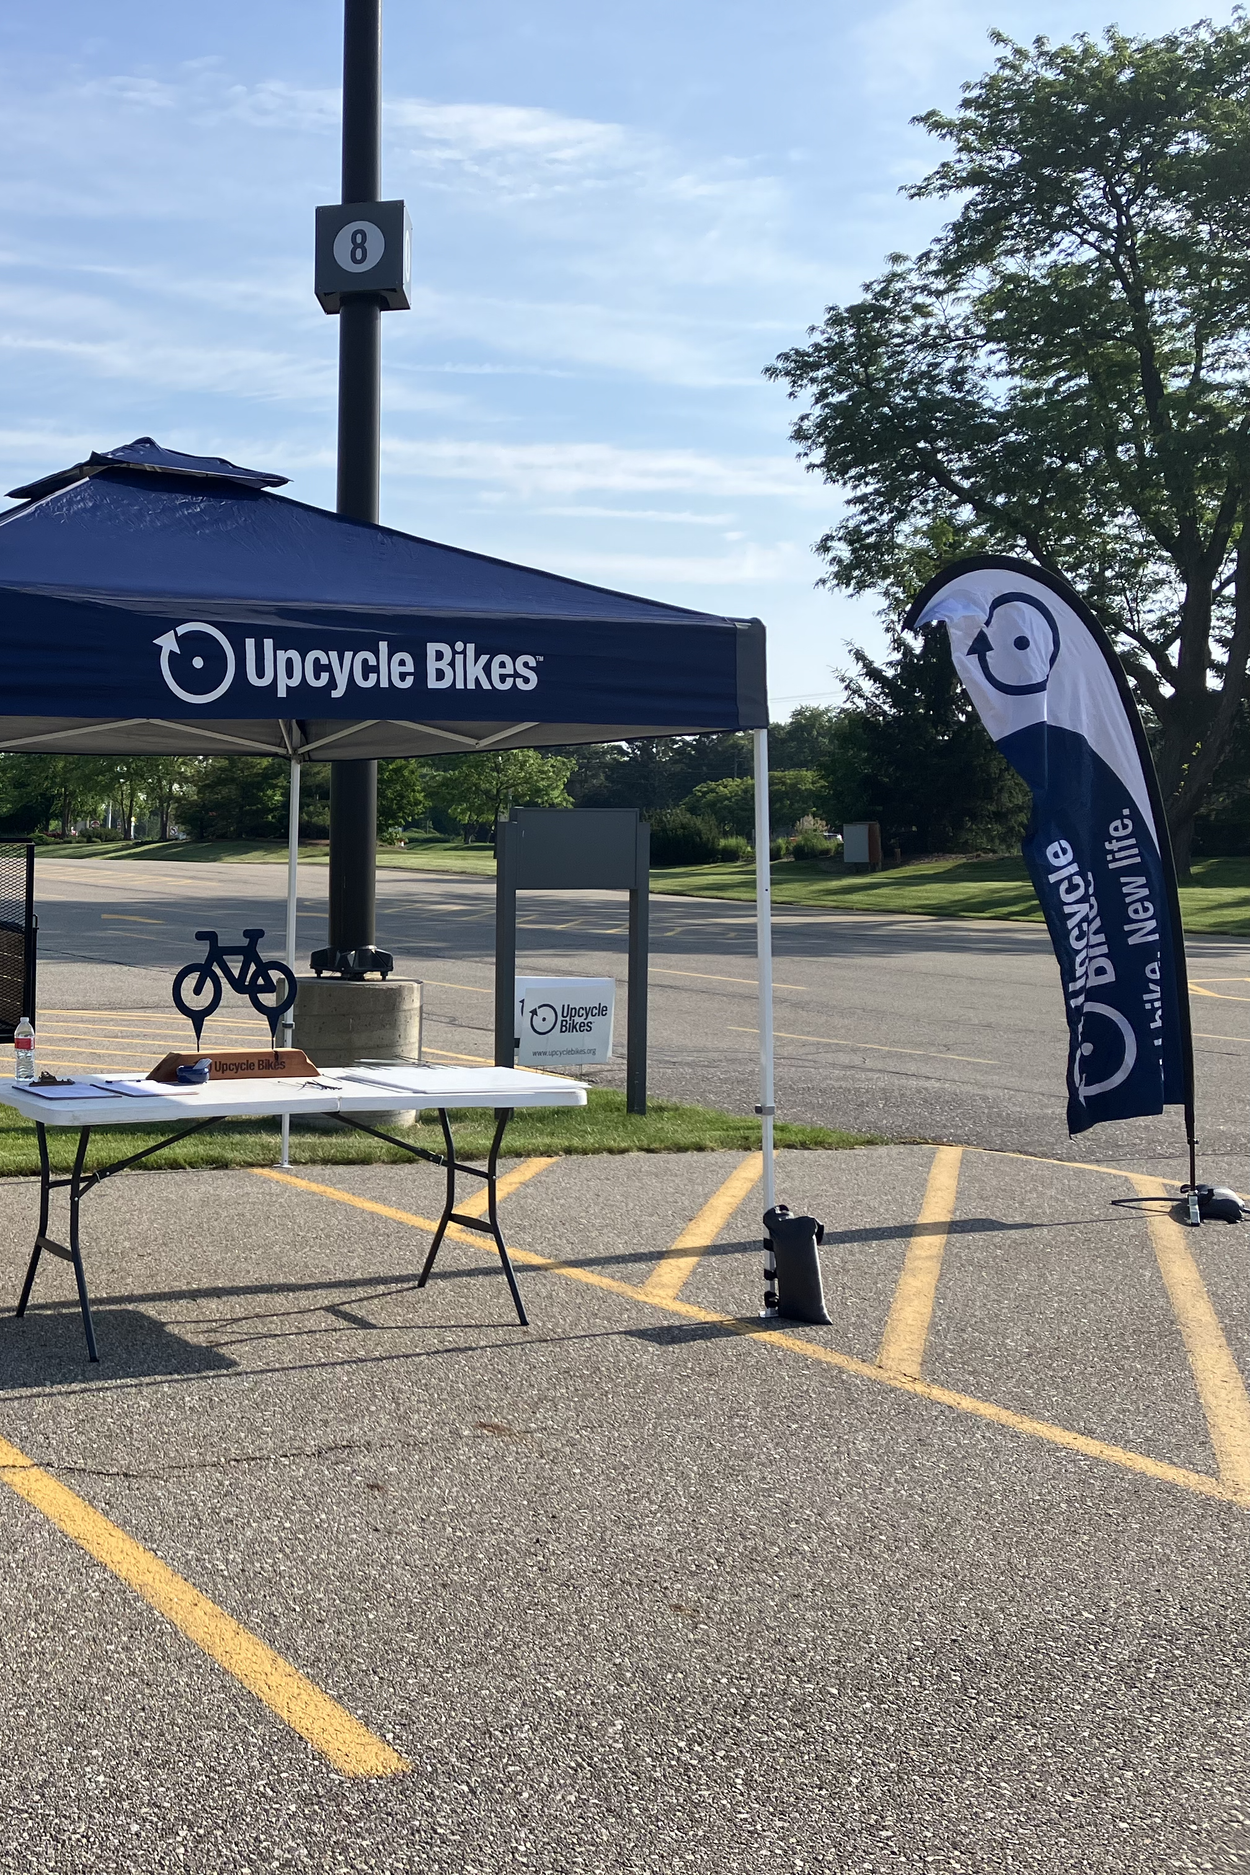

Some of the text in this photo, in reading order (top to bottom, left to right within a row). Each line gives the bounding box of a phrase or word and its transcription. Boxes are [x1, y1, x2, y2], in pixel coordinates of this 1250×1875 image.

[350, 228, 368, 265] 8
[245, 638, 415, 698] Upcycle
[1105, 808, 1143, 869] life.
[1120, 876, 1160, 946] New
[561, 1003, 608, 1020] Upcycle
[560, 1019, 593, 1034] Bikes
[214, 1059, 286, 1074] Upcycle Bikes
[532, 1048, 597, 1058] www.upcyclebikes.org
